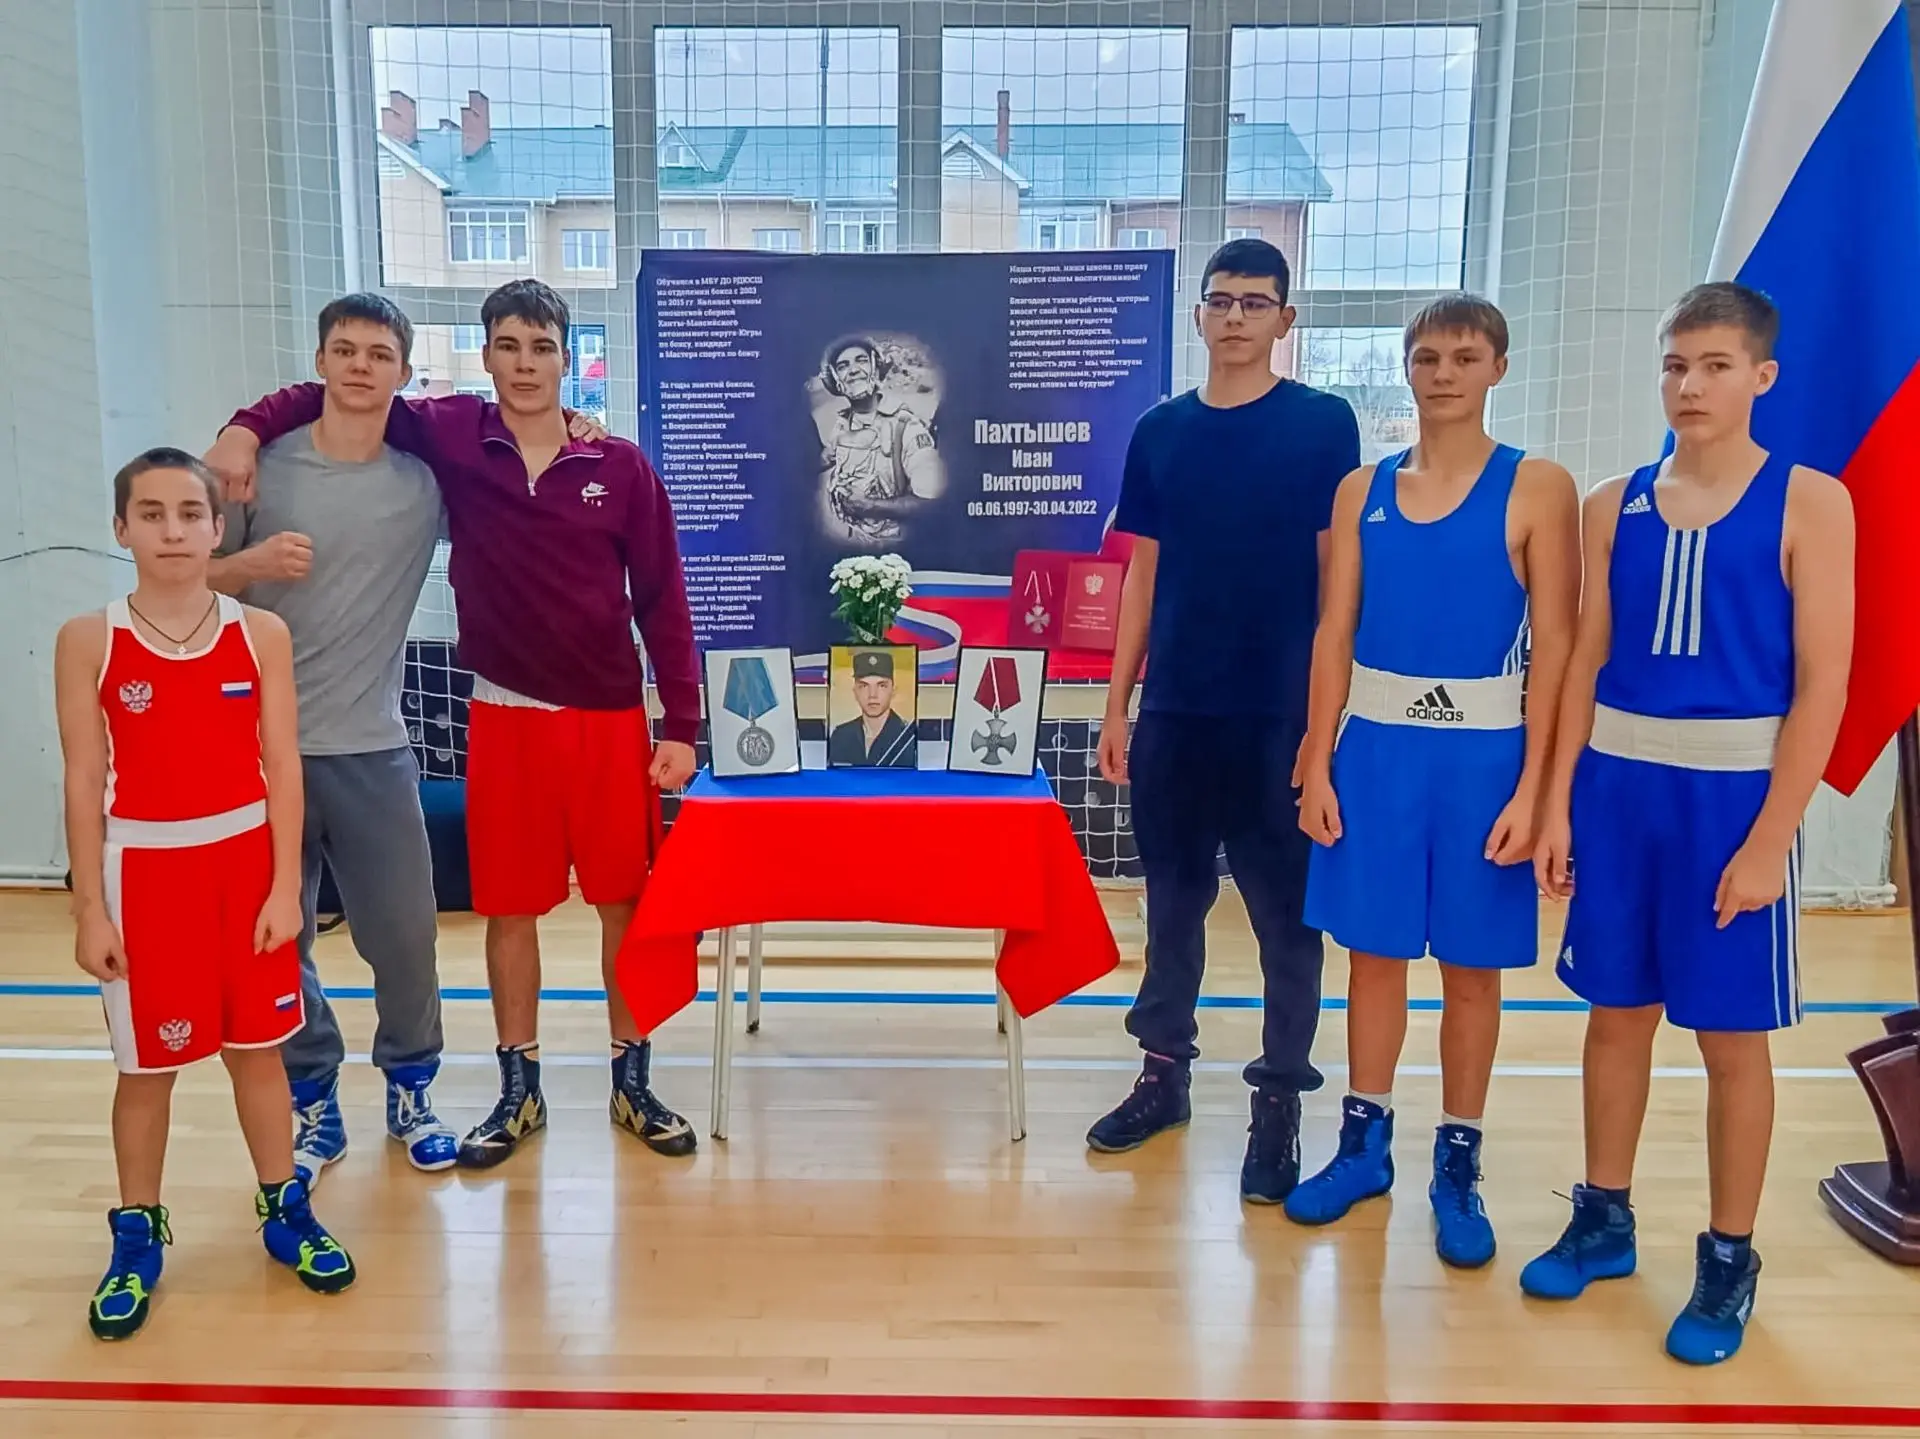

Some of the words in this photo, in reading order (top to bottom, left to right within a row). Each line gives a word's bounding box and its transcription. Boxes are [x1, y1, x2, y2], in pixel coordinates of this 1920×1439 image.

[1010, 297, 1050, 305] Благодаря
[704, 308, 735, 317] сборной
[669, 422, 726, 430] Всероссийских
[974, 420, 1091, 444] Пахтышев
[702, 442, 747, 451] финальных
[1012, 449, 1053, 468] Иван
[710, 472, 737, 481] службу
[983, 473, 1082, 492] Викторович
[968, 500, 1097, 516] 06.06.1997-30.04.2022
[711, 513, 739, 521] службу
[1406, 707, 1464, 721] adidas
